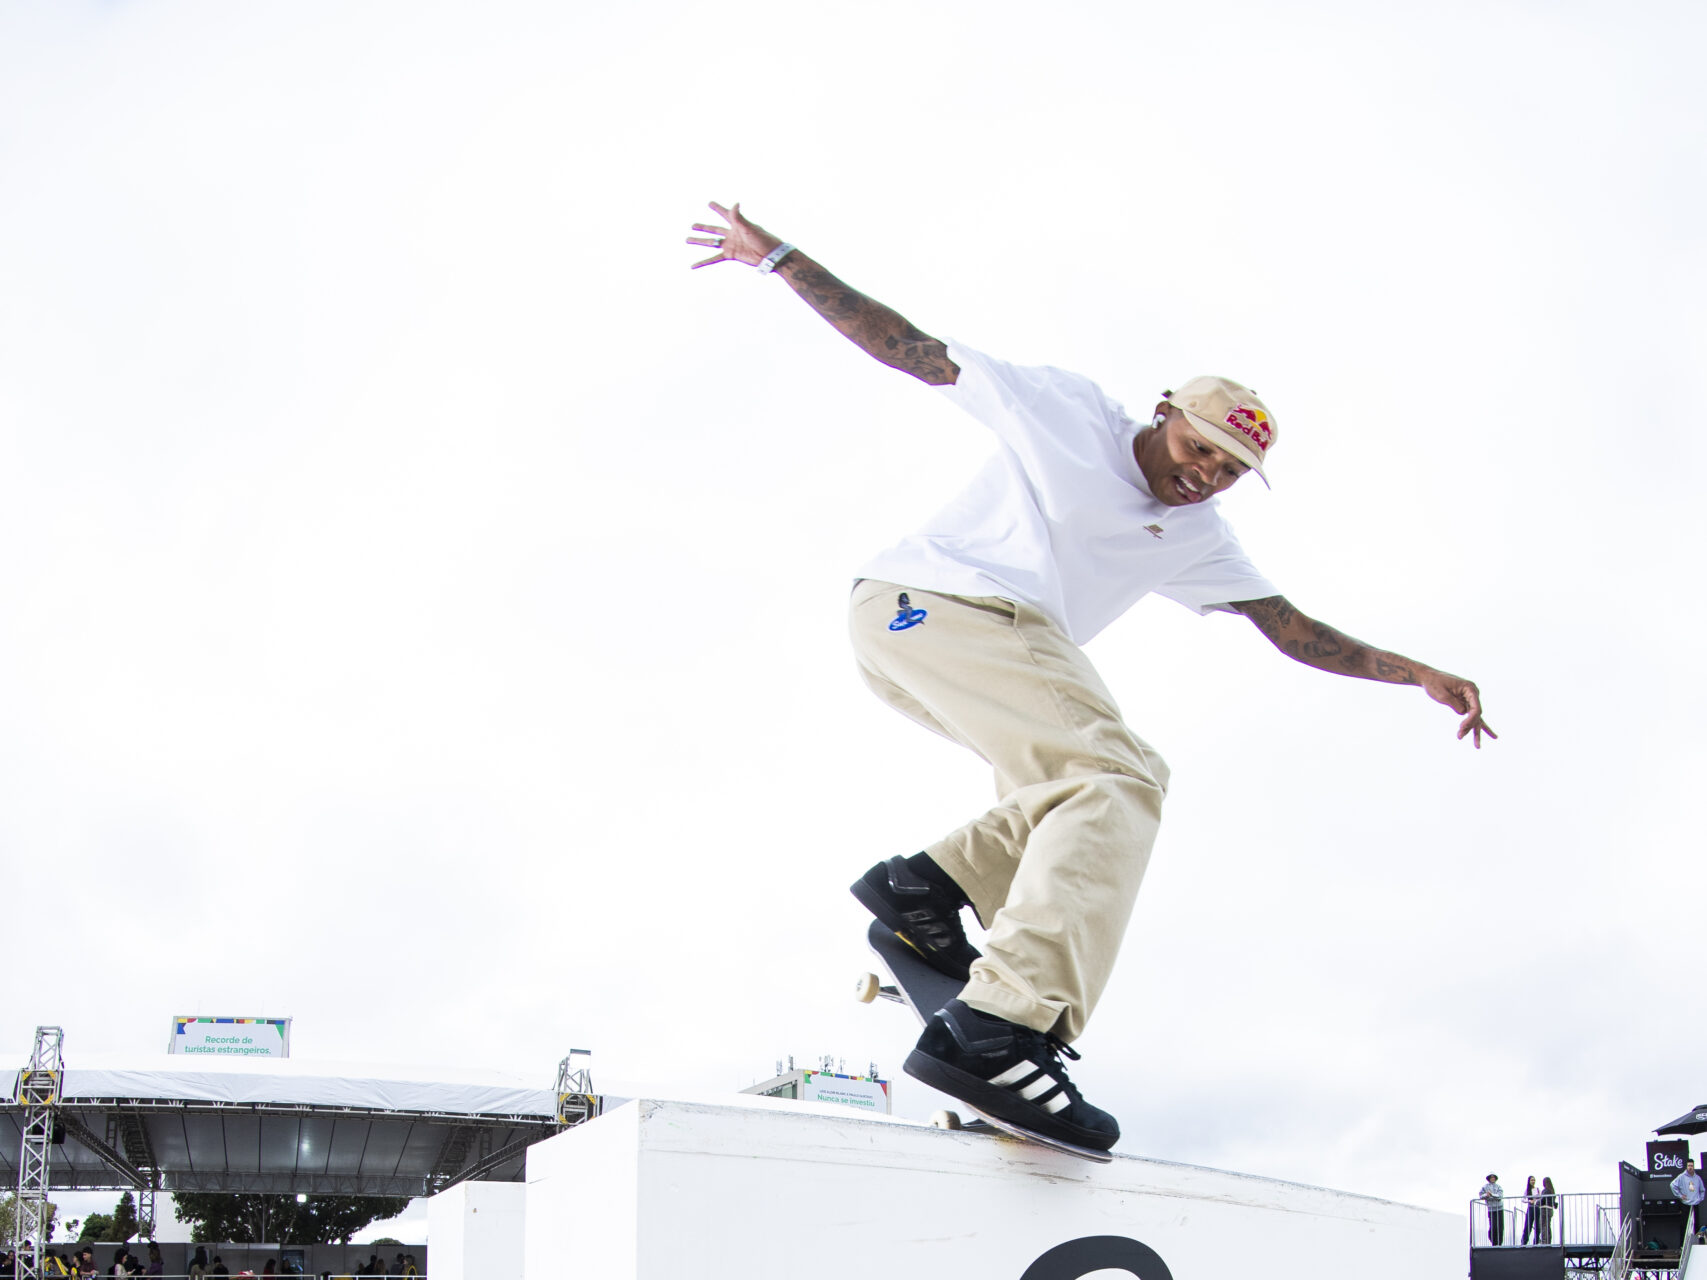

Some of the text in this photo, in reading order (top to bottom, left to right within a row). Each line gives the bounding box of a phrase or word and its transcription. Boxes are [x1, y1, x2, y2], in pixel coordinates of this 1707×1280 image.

[1226, 413, 1254, 436] Red
[205, 1035, 253, 1044] Recorde de
[184, 1045, 272, 1056] turistas estrangeiros.
[817, 1093, 840, 1103] Nunca
[849, 1097, 876, 1107] investiu
[1653, 1153, 1684, 1170] Stake
